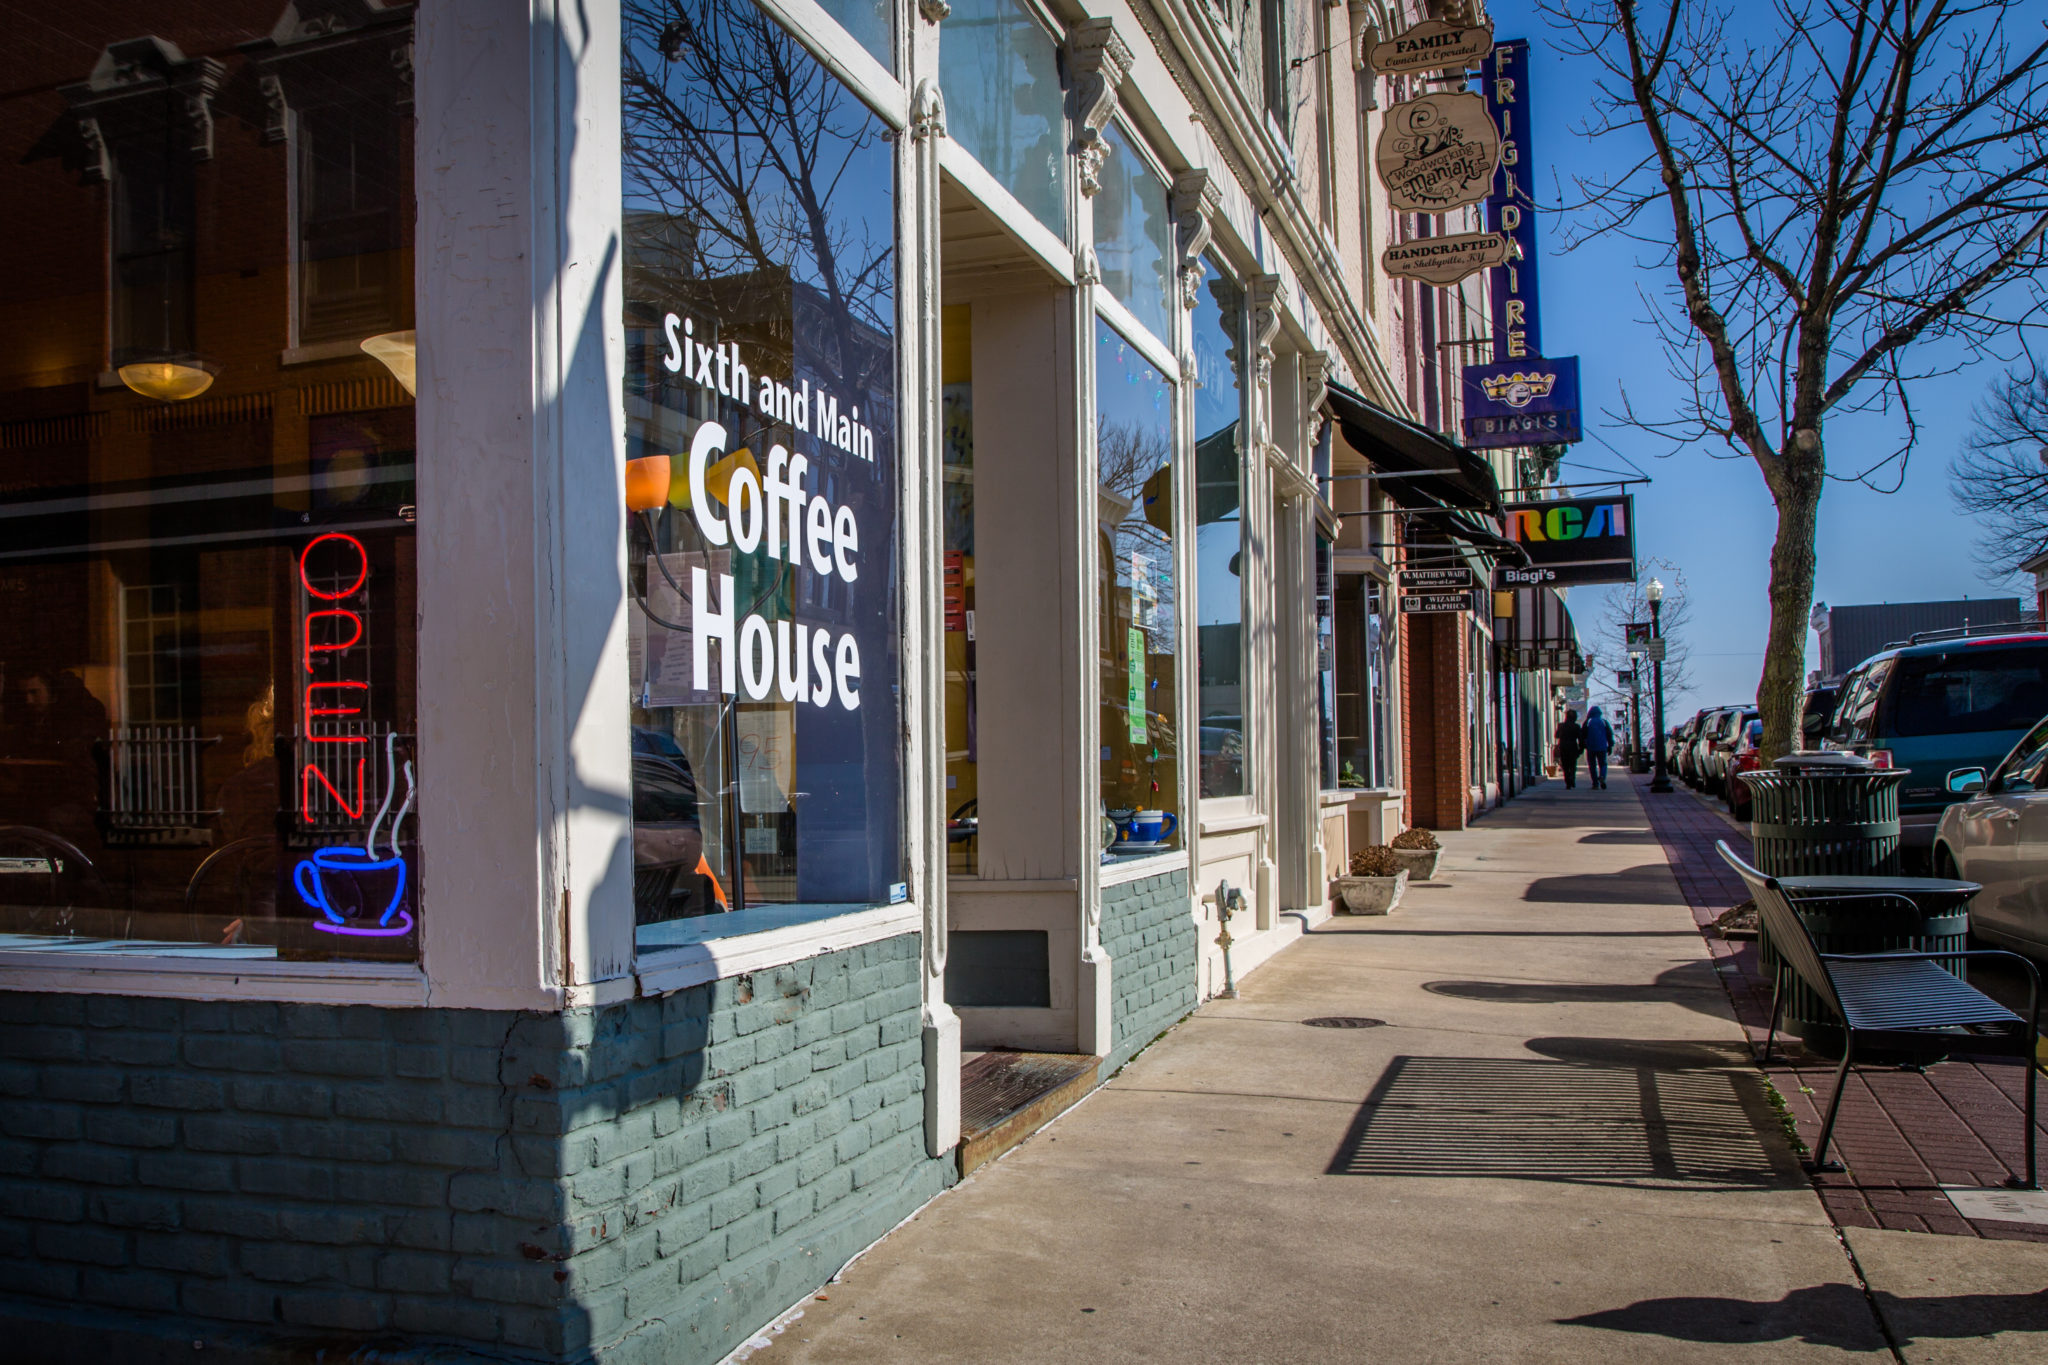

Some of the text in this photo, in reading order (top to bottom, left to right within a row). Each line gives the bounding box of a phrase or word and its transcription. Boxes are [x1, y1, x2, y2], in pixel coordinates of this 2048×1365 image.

[1385, 43, 1477, 67] Owned & Operated
[1396, 31, 1464, 53] FAMILY
[1394, 145, 1474, 180] Woodworking
[1496, 47, 1527, 358] FRIGIDAIRE
[1389, 239, 1499, 260] HANDCRAFTED
[1402, 252, 1486, 270] in Shelbyville, KY
[664, 312, 874, 463] Sixth and Main
[1485, 415, 1557, 433] BIAGI'S
[688, 421, 859, 583] Coffee
[1505, 504, 1625, 542] RCA
[1412, 570, 1446, 579] MATTHEW
[1447, 570, 1467, 578] WADE
[1505, 569, 1556, 584] Biagi's
[1425, 603, 1466, 611] GRAPHICS
[691, 567, 860, 711] House
[301, 532, 367, 823] OPEN
[740, 733, 783, 771] 95
